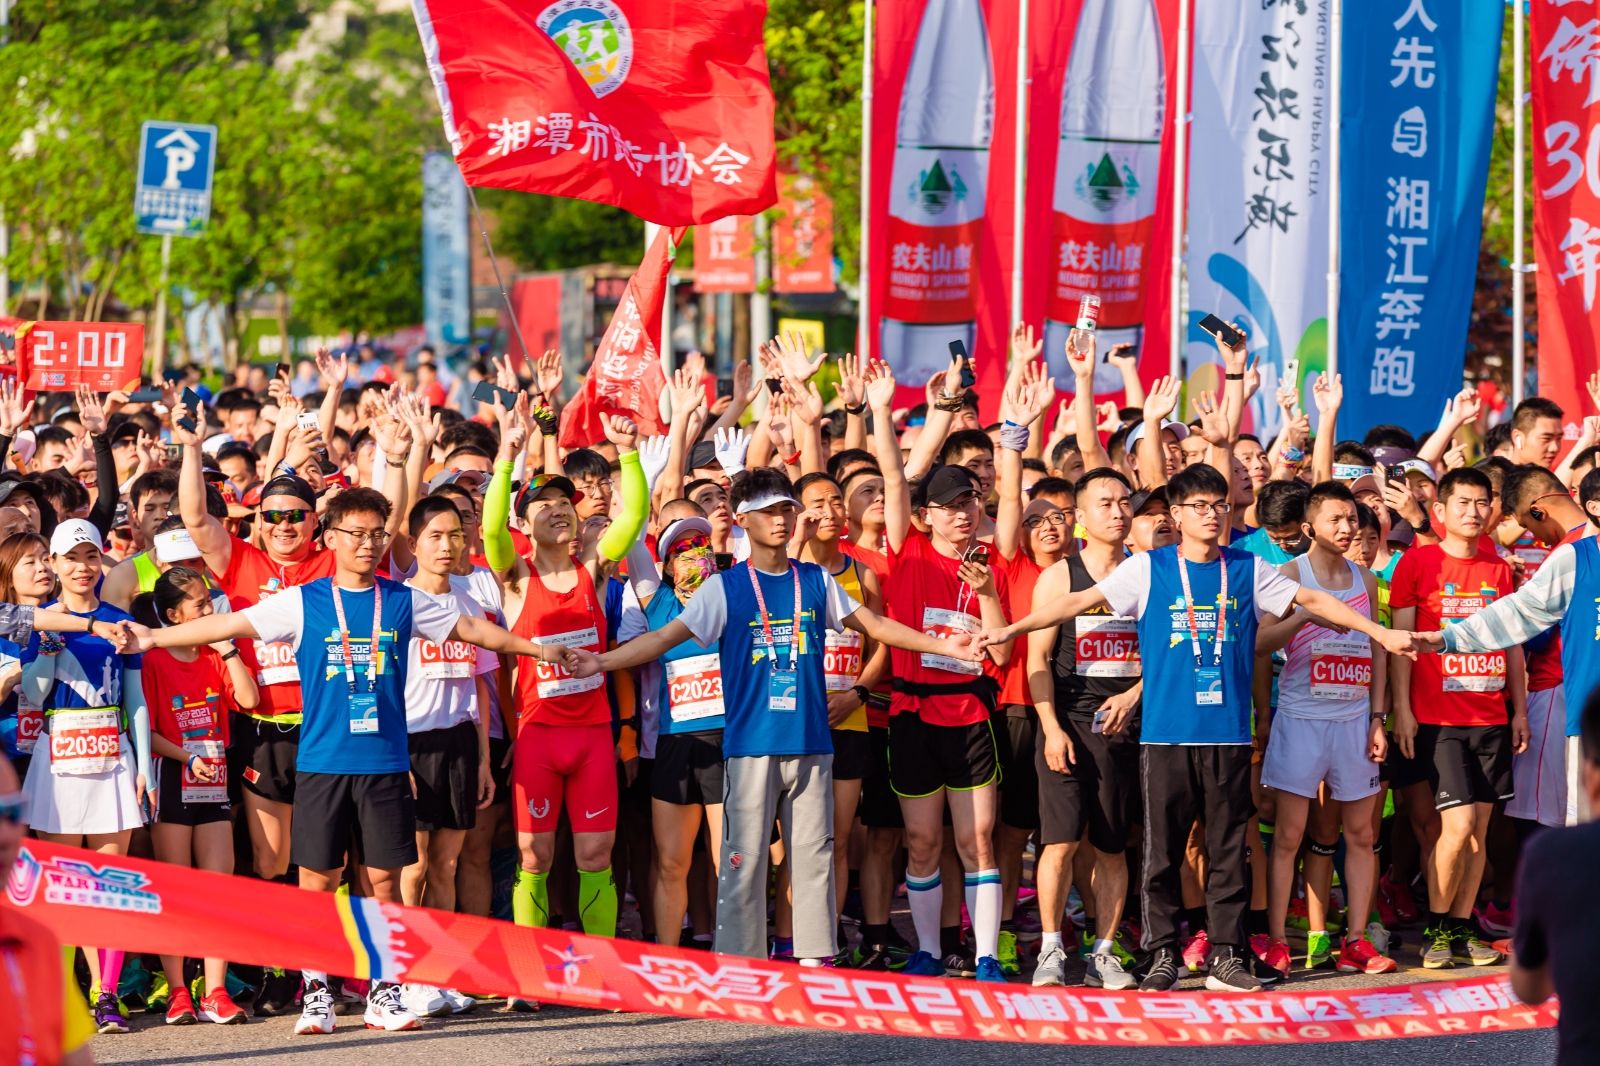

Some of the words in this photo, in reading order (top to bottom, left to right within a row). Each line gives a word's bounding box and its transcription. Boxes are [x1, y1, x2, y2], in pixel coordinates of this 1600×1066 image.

[487, 112, 750, 187] 湘潭市协会
[163, 146, 196, 189] P
[892, 242, 973, 271] 农夫山泉
[1059, 240, 1143, 271] 农夫山泉
[33, 330, 126, 367] 2:00
[1314, 661, 1371, 682] C10466
[1445, 655, 1505, 674] C10349
[52, 735, 118, 757] C20365
[49, 873, 89, 890] WAR
[643, 992, 962, 1036] WARHORSE
